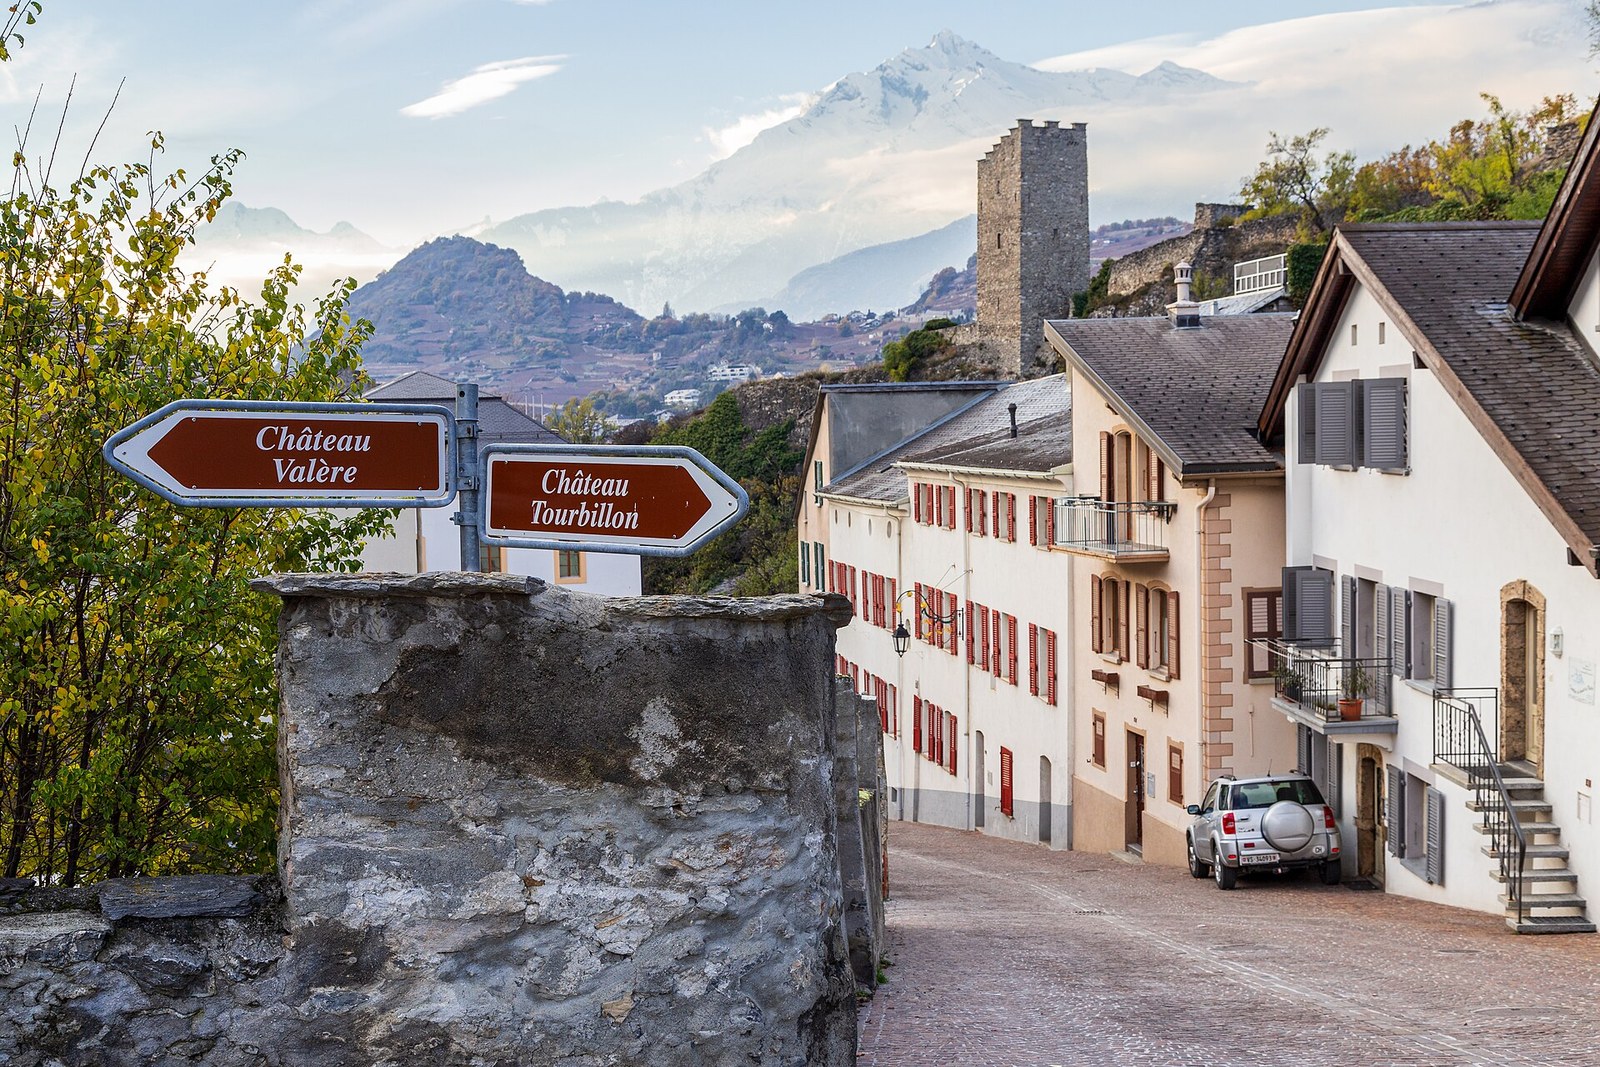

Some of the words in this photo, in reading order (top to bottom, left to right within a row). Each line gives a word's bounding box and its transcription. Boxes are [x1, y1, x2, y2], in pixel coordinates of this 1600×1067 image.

[256, 426, 371, 451] Château
[273, 458, 358, 483] Valère
[541, 469, 629, 497] Château
[531, 500, 639, 529] Tourbillon
